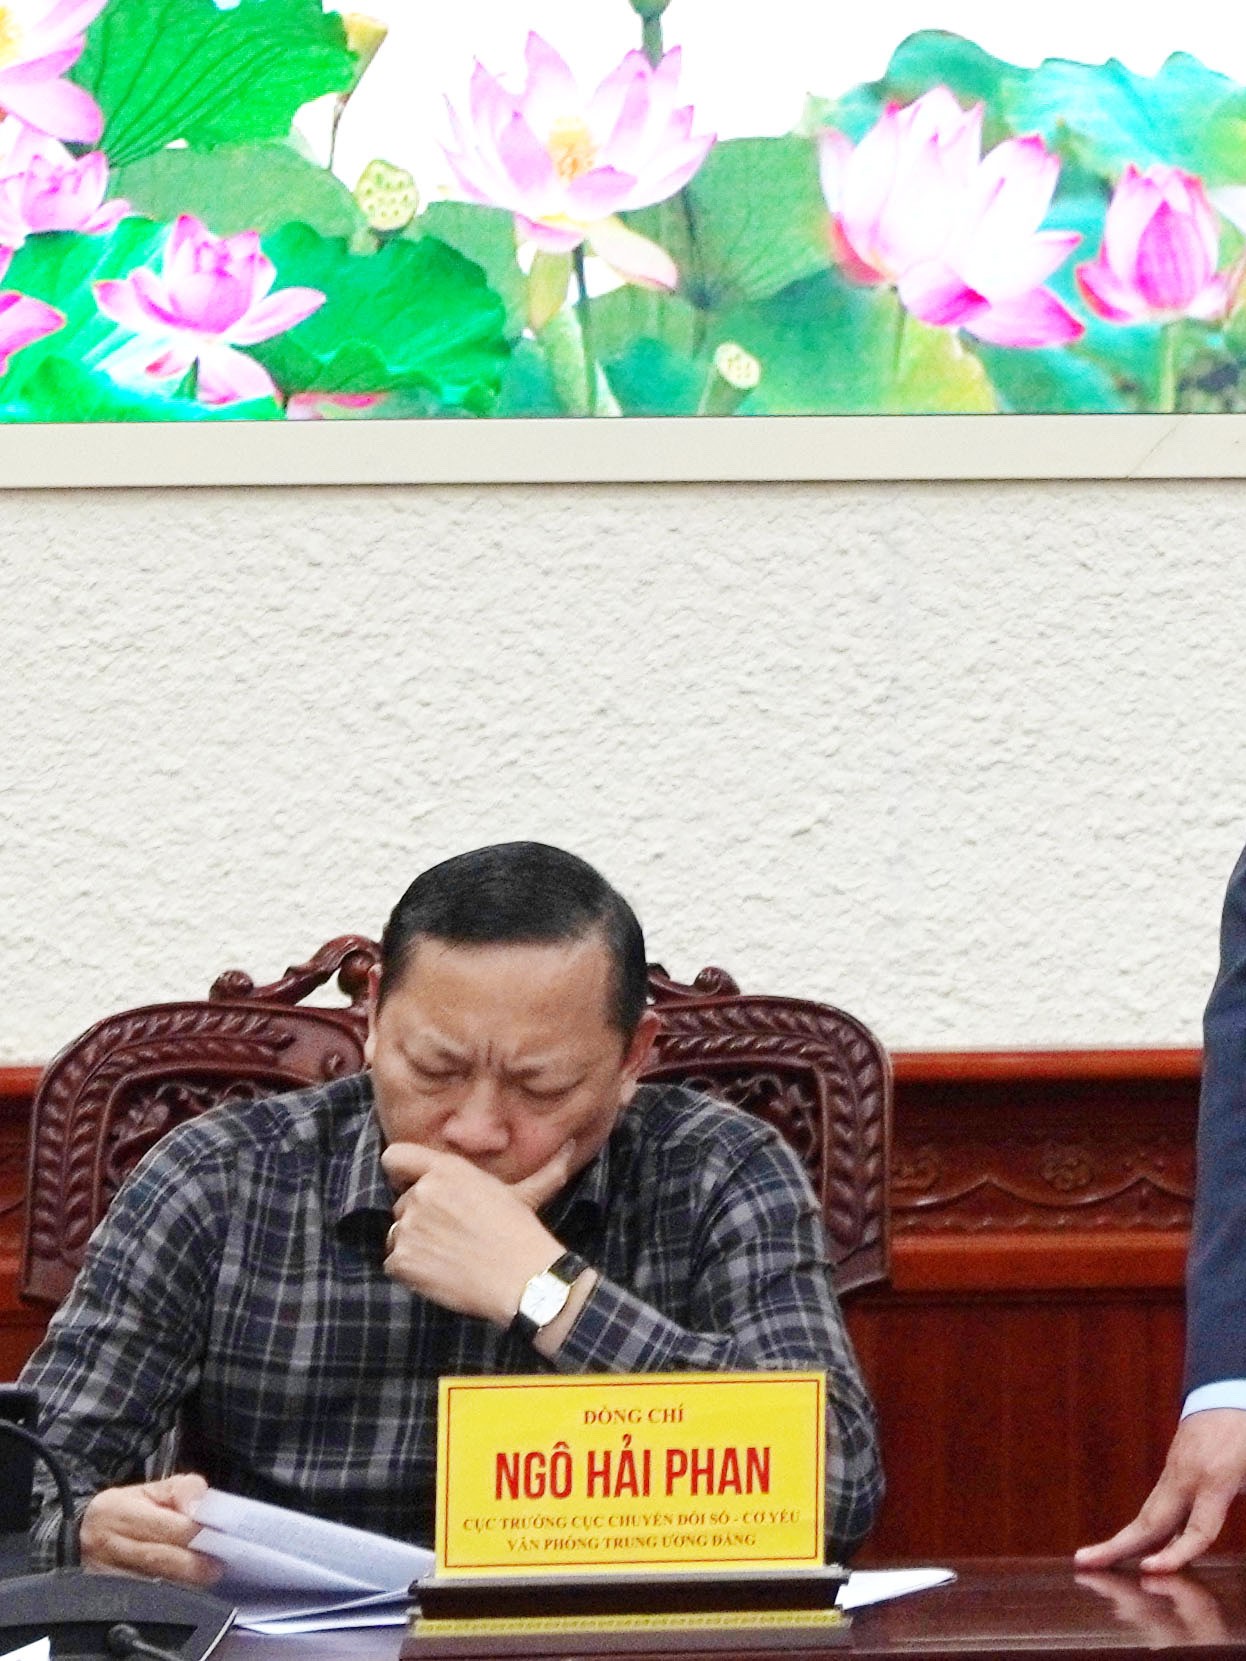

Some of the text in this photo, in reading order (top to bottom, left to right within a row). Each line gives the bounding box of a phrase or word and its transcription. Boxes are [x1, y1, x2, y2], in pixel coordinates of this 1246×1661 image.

[583, 1402, 685, 1425] ĐỒNG CHÍ
[495, 1434, 771, 1501] NGÔ HẢI PHAN
[463, 1517, 496, 1532] CỤC
[571, 1515, 603, 1531] CỤC
[603, 1535, 658, 1550] TRUNG
[662, 1533, 708, 1548] ƯƠNG
